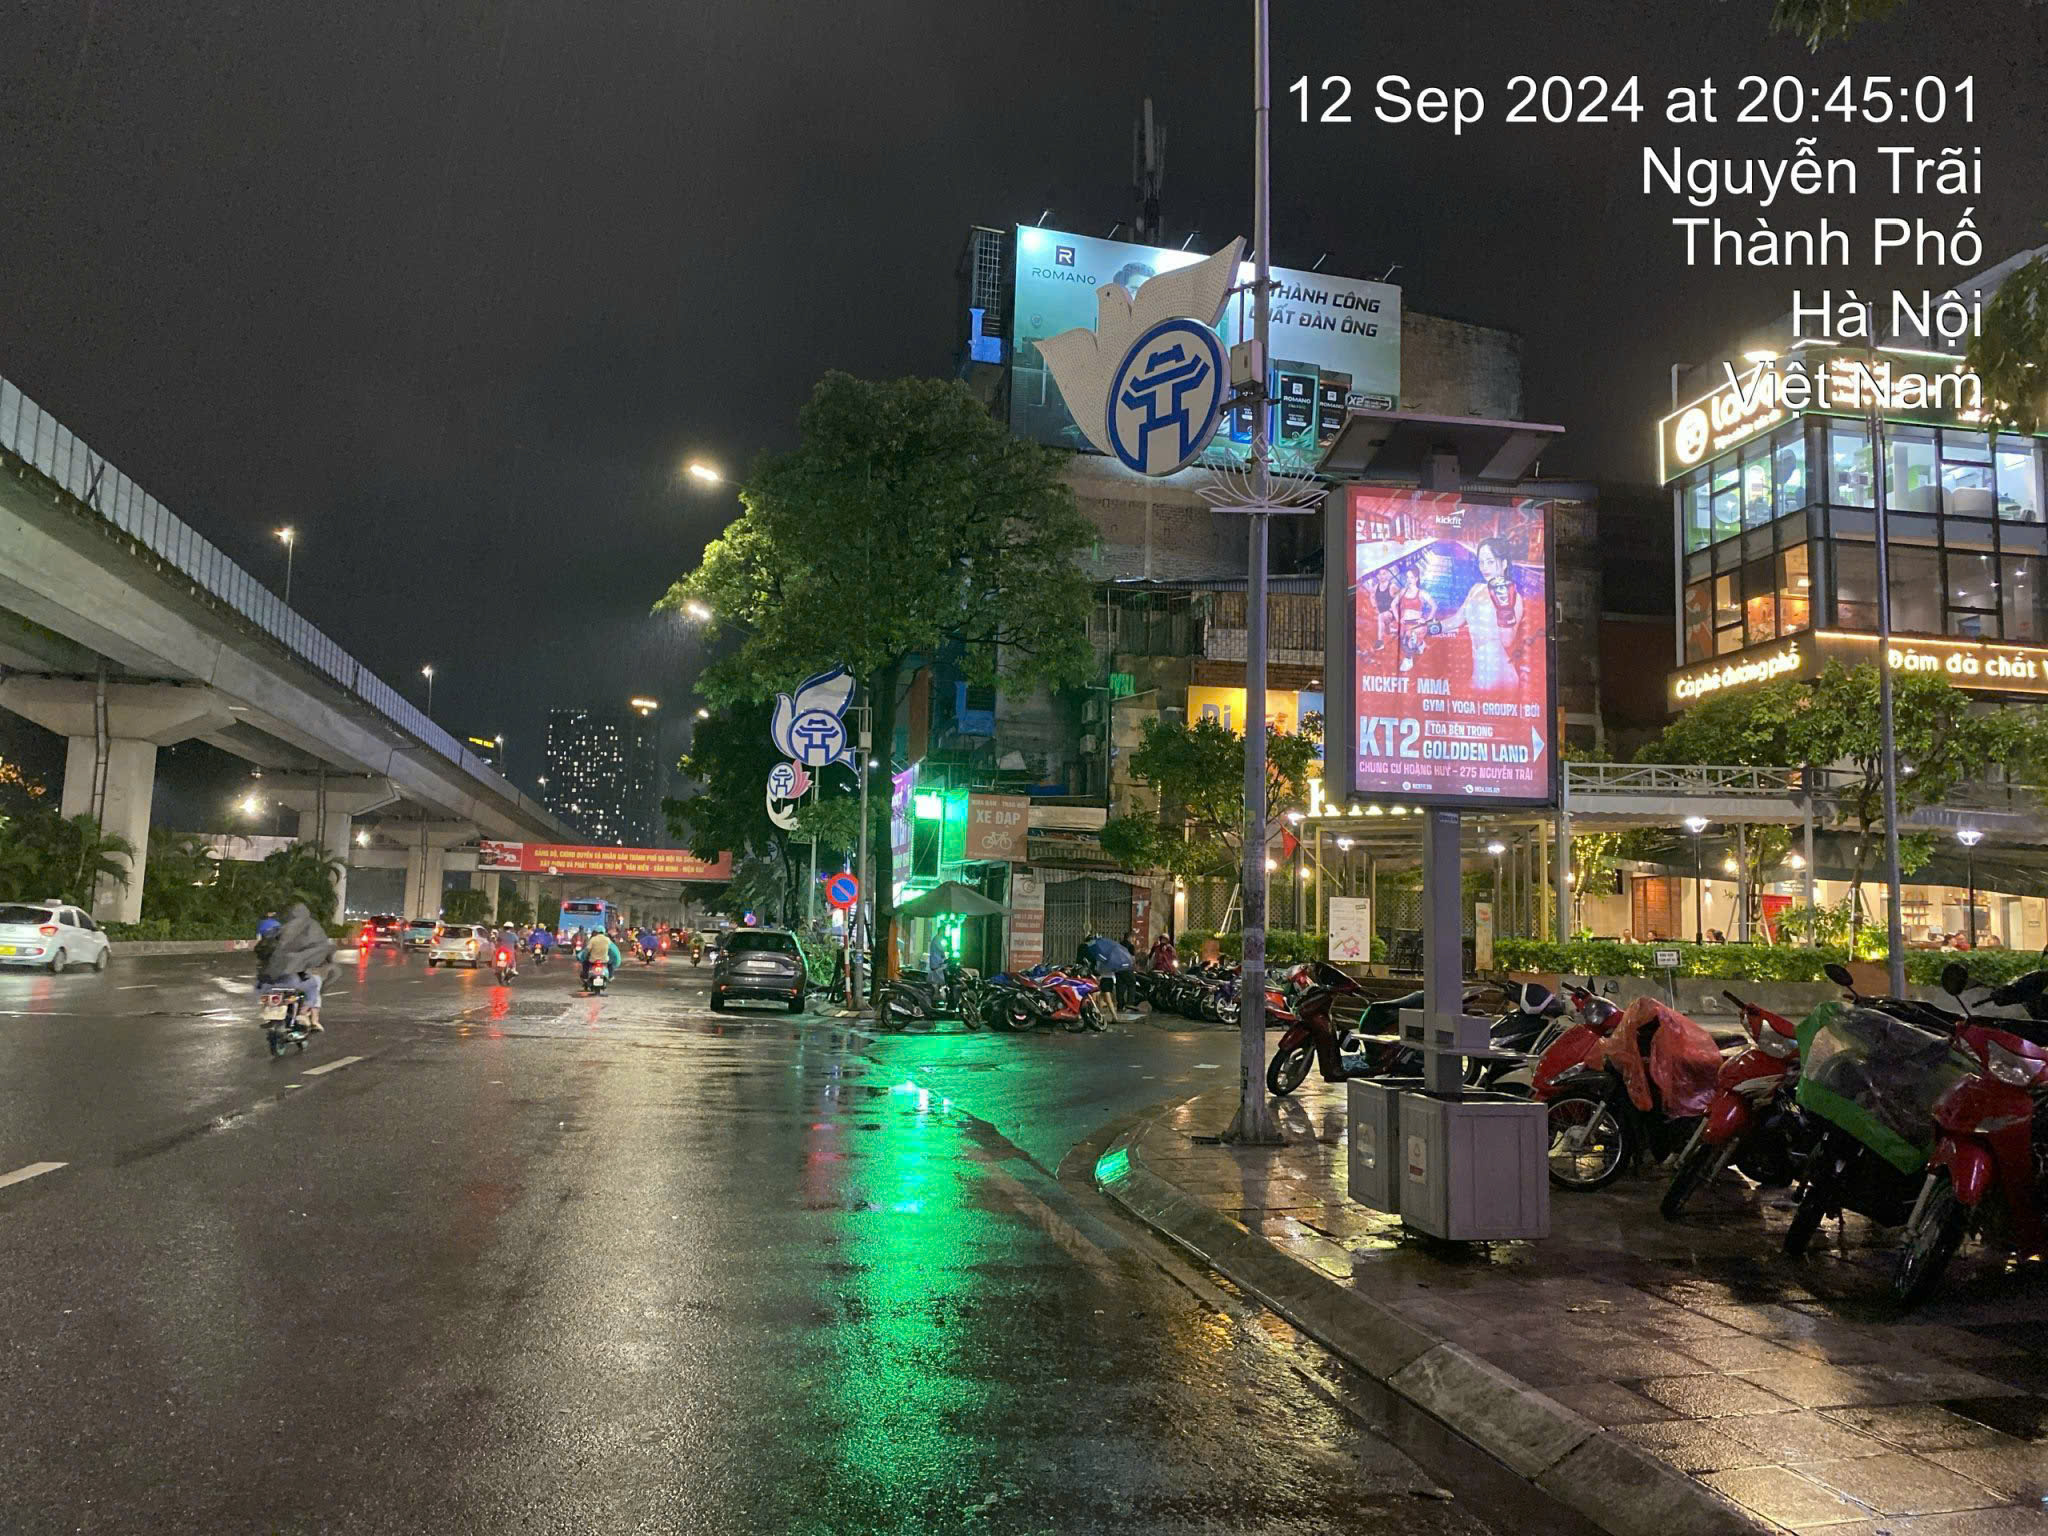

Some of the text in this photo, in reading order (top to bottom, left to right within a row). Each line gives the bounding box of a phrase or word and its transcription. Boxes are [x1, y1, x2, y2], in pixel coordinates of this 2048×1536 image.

[1032, 267, 1096, 285] ROMANO
[1332, 291, 1381, 313] CÔNG
[1299, 311, 1337, 332] ĐÀN
[1340, 314, 1379, 338] ÔNG
[1283, 395, 1312, 405] ROMANO
[1319, 401, 1345, 410] ROMANO
[1347, 394, 1365, 406] X2
[1435, 513, 1463, 526] kickfit
[1945, 652, 1979, 676] đà
[1985, 651, 2038, 679] chất
[1362, 674, 1450, 696] KICKFIT MMA
[1422, 698, 1445, 713] GYM
[1451, 700, 1476, 715] YOGA
[1482, 702, 1518, 717] GROUPX
[1359, 715, 1420, 758] KT2
[1449, 721, 1465, 736] BÊN
[1466, 723, 1494, 738] TRONG
[1422, 740, 1529, 764] GOLDDEN LAND
[1359, 761, 1389, 773] CHUNG
[1460, 766, 1477, 779] 275
[976, 808, 993, 824] XE
